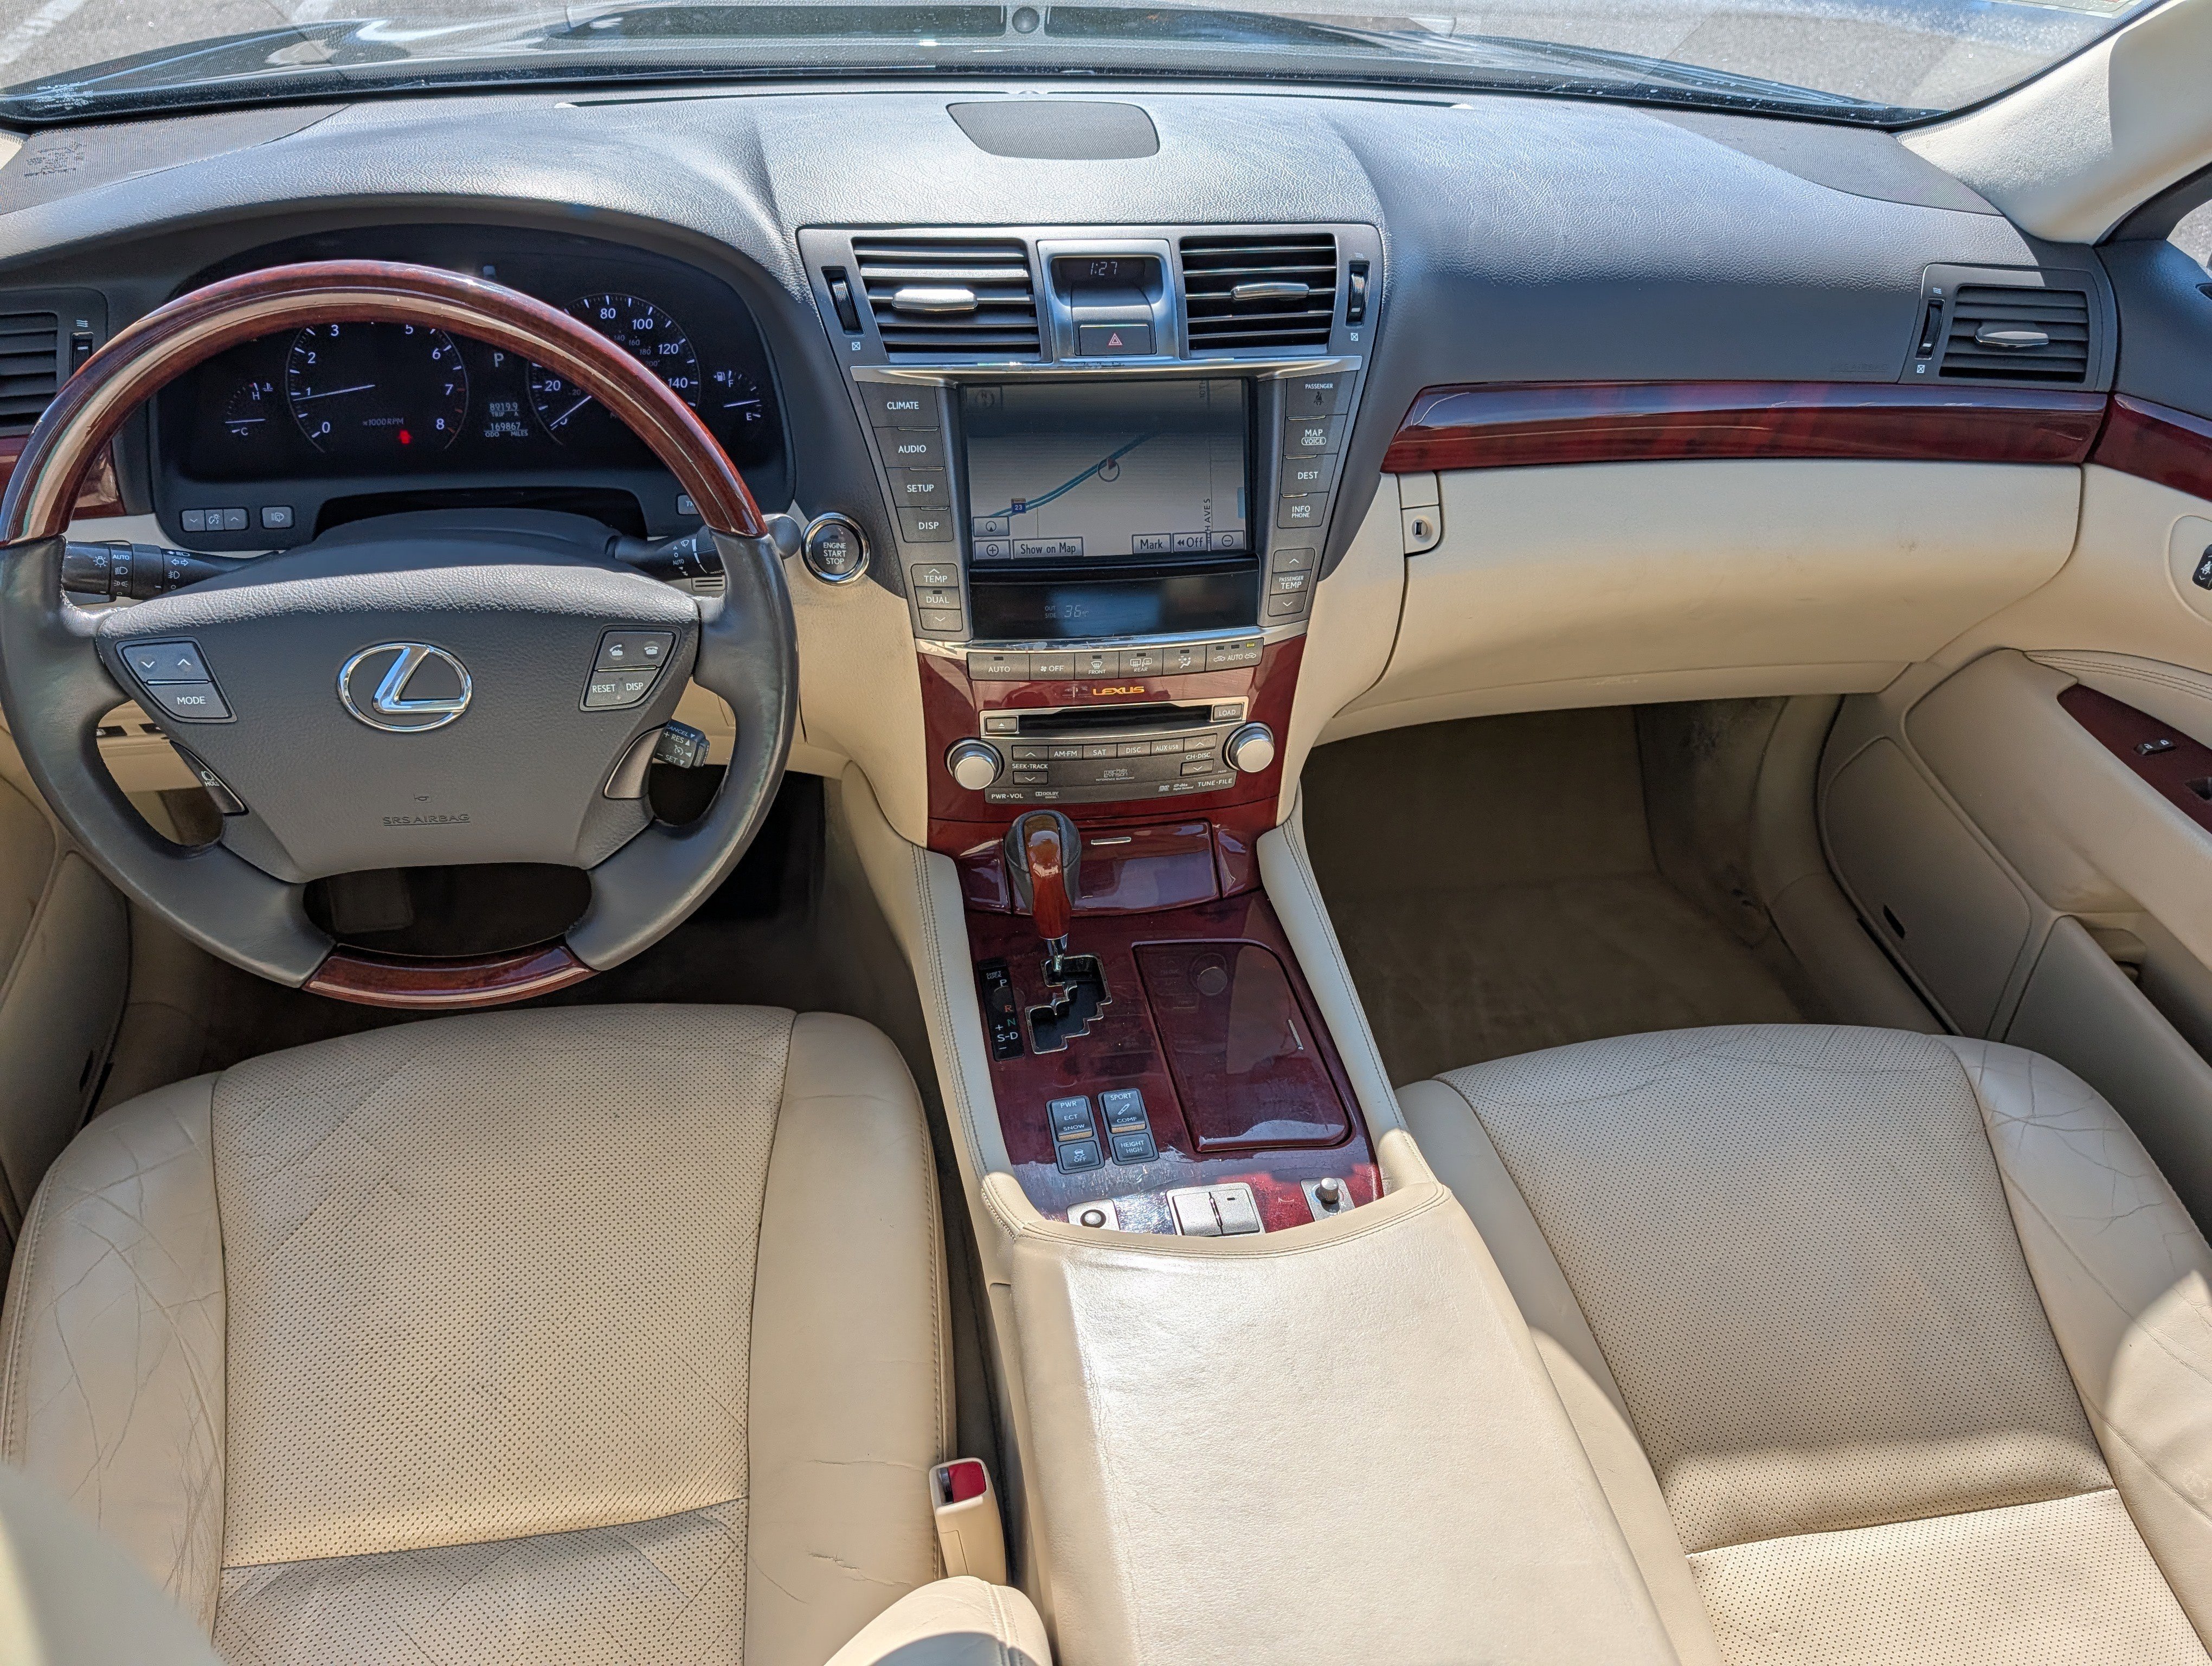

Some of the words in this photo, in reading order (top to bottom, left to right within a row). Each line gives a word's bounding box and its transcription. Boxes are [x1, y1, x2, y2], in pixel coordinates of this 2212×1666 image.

[1090, 261, 1117, 275] 1:27
[600, 308, 616, 319] 80
[632, 318, 653, 330] 100
[331, 325, 339, 336] 3
[405, 324, 414, 335] 5
[432, 349, 441, 360] 6
[658, 344, 678, 355] 120
[307, 353, 316, 364] 2
[494, 353, 504, 367] P
[544, 380, 561, 392] 20
[668, 377, 688, 388] 140
[728, 380, 734, 388] F
[306, 387, 311, 395] 1
[445, 384, 453, 395] 7
[252, 392, 260, 400] H
[887, 401, 919, 409] CLIMATE
[747, 412, 753, 421] E
[322, 422, 331, 433] 0
[436, 419, 444, 430] 8
[241, 427, 248, 435] C
[1305, 429, 1323, 437] MAP
[898, 445, 926, 453] AUDIO
[1297, 471, 1319, 479] DEST
[907, 484, 934, 492] SETUP
[918, 522, 939, 530] DISP
[1140, 540, 1163, 550] Mark
[1186, 537, 1203, 547] Off
[1020, 544, 1043, 555] Show
[1059, 544, 1076, 556] Map
[1281, 581, 1302, 589] TEMP
[592, 684, 615, 693] RESET
[626, 682, 644, 691] DISP
[1093, 686, 1144, 696] LEXUS
[177, 696, 206, 705] MODE
[671, 734, 684, 744] RES
[665, 754, 678, 763] SET
[383, 816, 410, 824] SRS
[414, 814, 470, 824] AIRBAG
[1007, 1018, 1017, 1027] N
[1110, 1093, 1131, 1101] SPORT
[1121, 1140, 1144, 1148] HEIGHT
